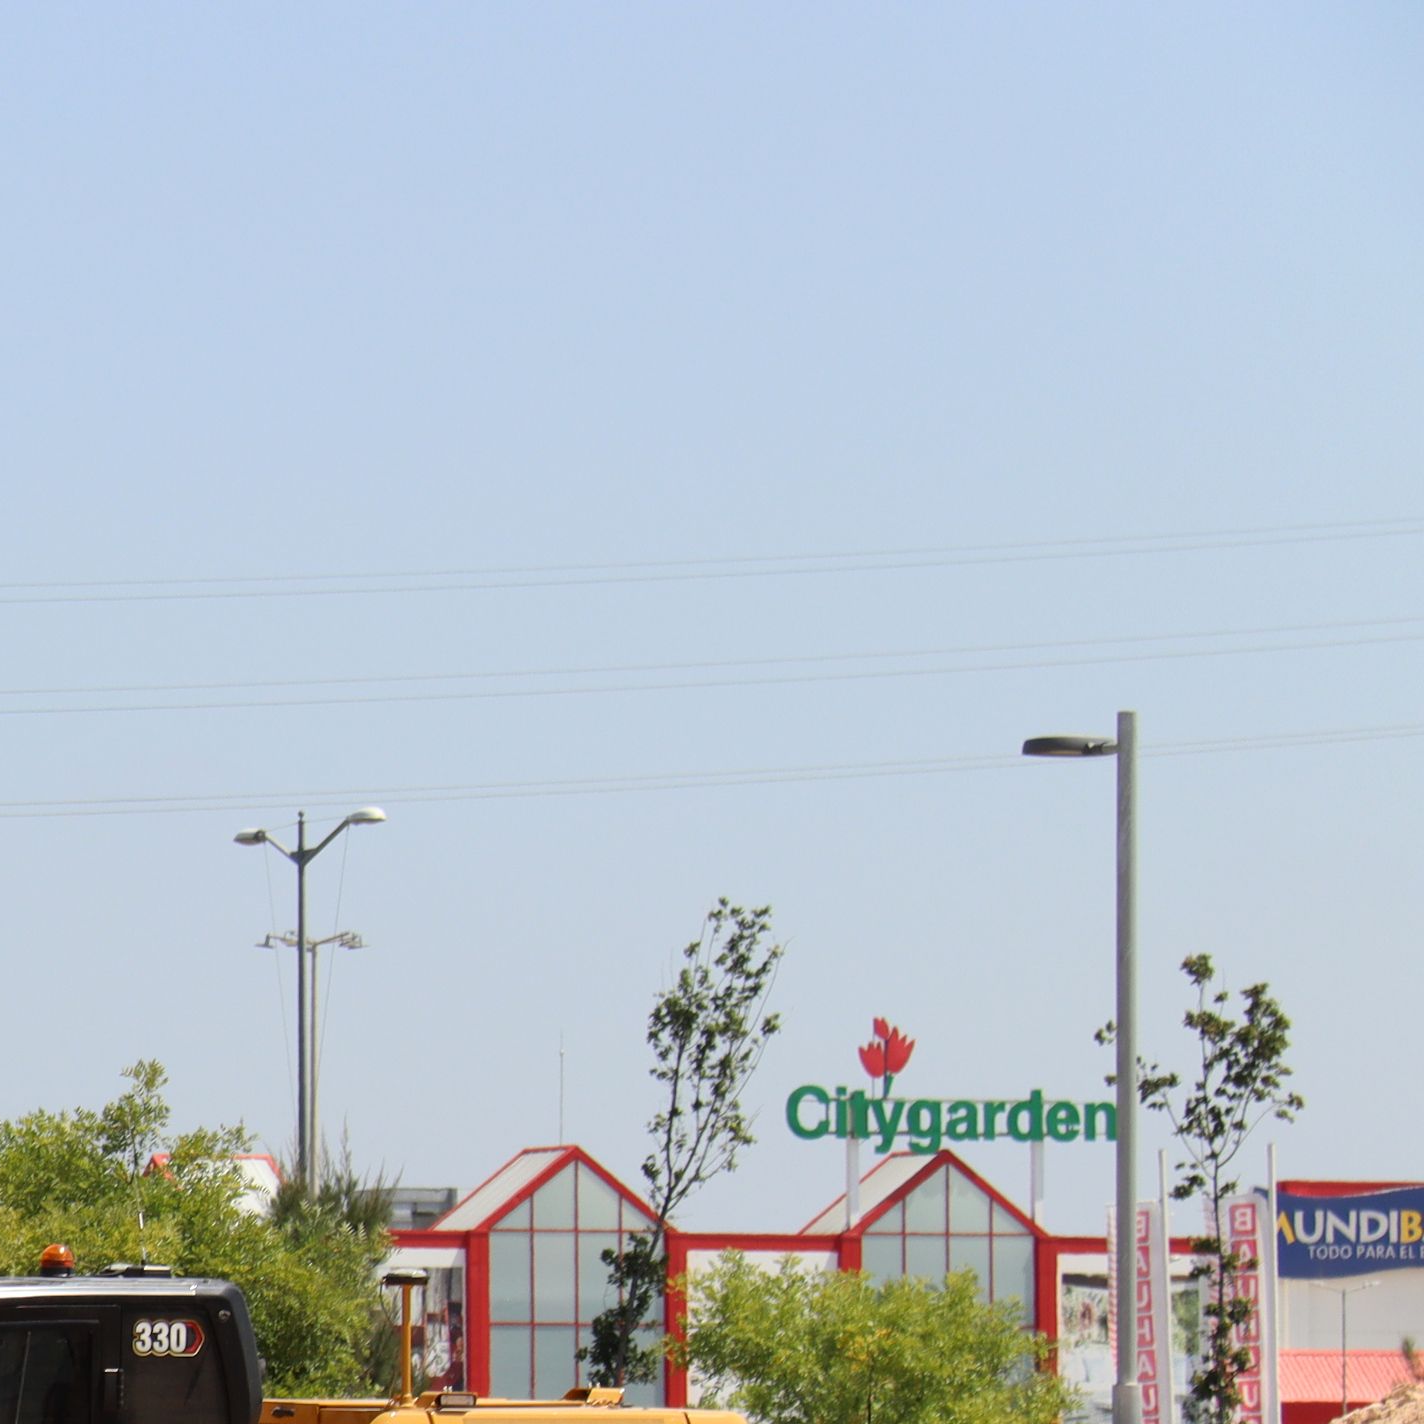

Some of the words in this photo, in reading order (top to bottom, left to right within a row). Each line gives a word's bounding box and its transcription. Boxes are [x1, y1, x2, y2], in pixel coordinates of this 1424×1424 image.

[786, 1085, 1116, 1155] Citygarden
[1277, 1210, 1424, 1245] UNDIB
[1308, 1245, 1352, 1260] TODO
[1357, 1244, 1395, 1259] PARA
[1400, 1244, 1415, 1259] EL
[135, 1321, 187, 1353] 330
